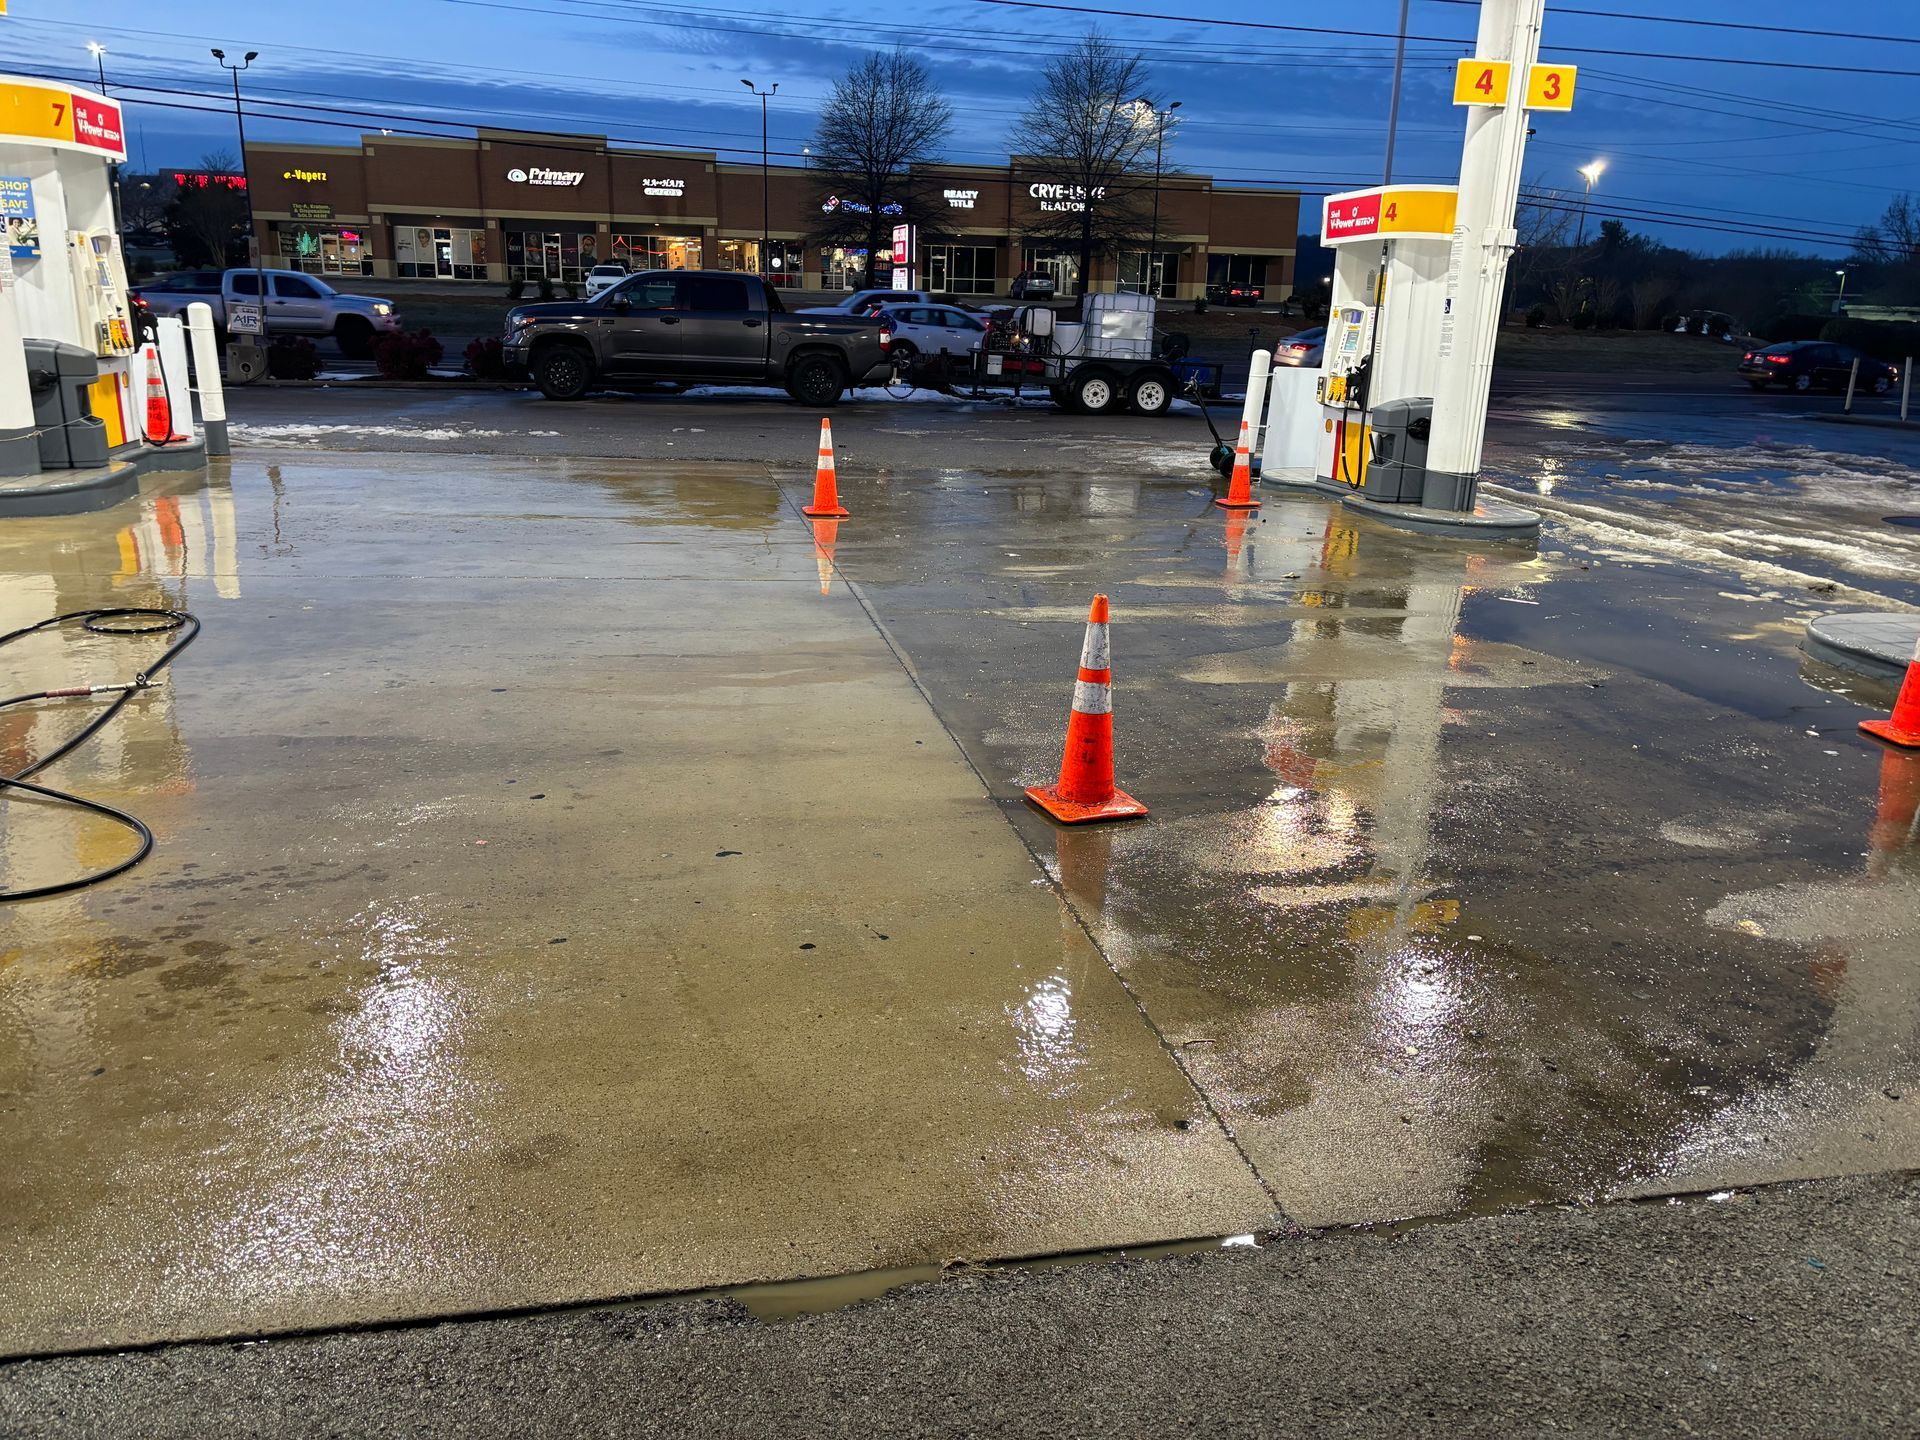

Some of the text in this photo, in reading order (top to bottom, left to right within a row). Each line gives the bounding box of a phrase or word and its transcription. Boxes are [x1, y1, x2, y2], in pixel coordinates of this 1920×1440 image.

[1475, 69, 1493, 95] 4
[1543, 73, 1561, 100] 3
[52, 103, 65, 126] 7
[76, 108, 87, 119] Shell
[77, 119, 103, 137] V-Power
[283, 169, 327, 183] e-Vaperz
[529, 167, 585, 186] Primary
[0, 181, 29, 191] SHOP
[944, 189, 979, 199] REALTY
[2, 198, 28, 208] SAVE
[949, 199, 975, 208] TITLE
[1040, 201, 1094, 212] REALTOR
[1330, 209, 1341, 218] Shell
[1385, 202, 1397, 221] 4
[1330, 217, 1355, 230] V-Power
[234, 314, 257, 324] AIR
